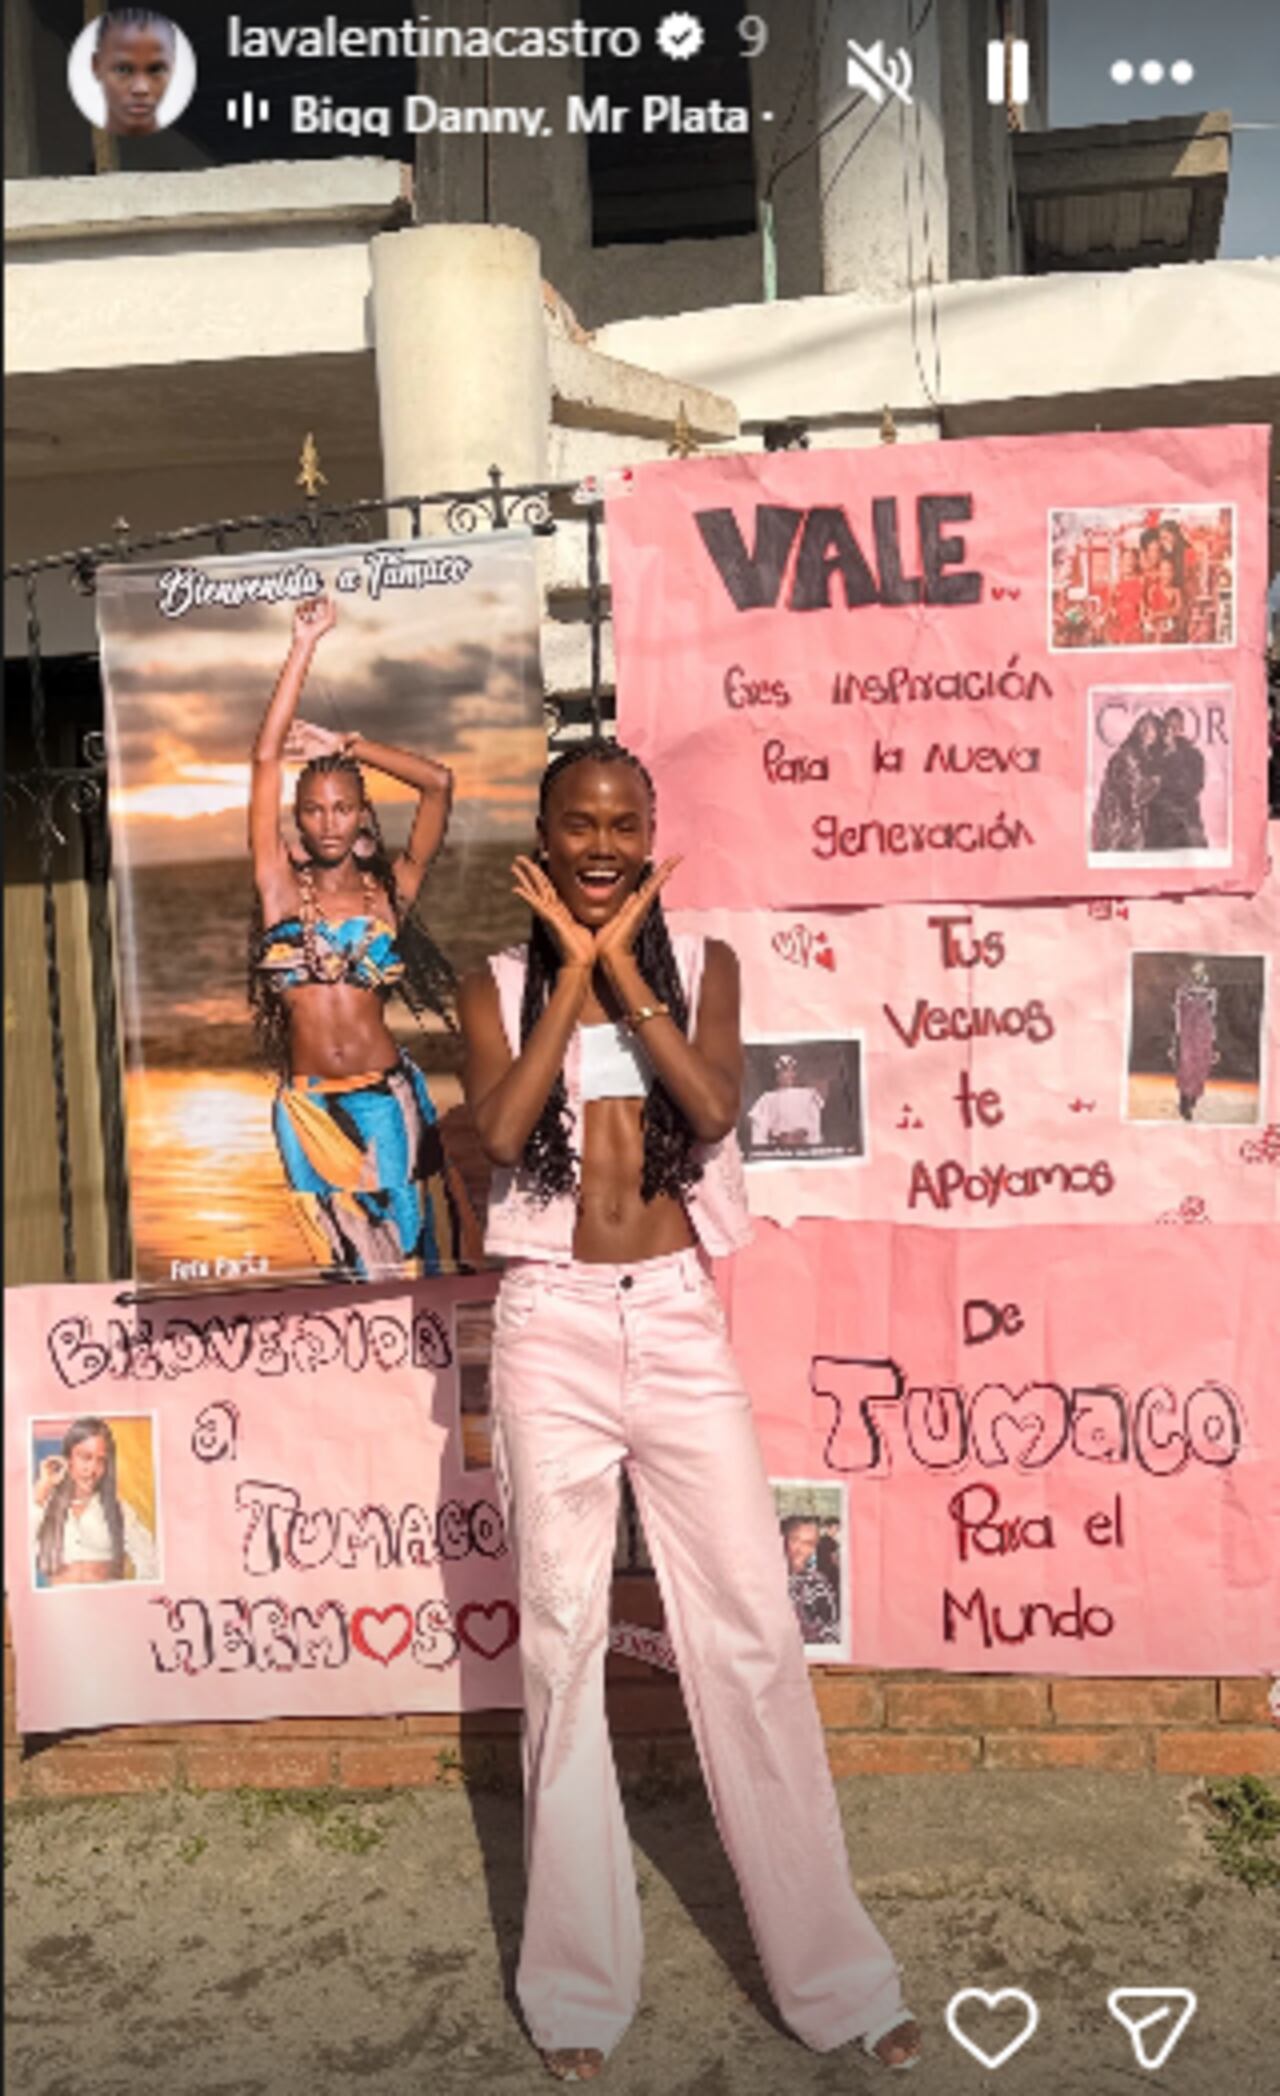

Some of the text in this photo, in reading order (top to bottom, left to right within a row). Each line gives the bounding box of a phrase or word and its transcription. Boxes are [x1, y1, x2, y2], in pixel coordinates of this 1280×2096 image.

[694, 493, 983, 613] VALE
[157, 564, 324, 619] Bienvenida
[336, 567, 361, 593] a
[723, 665, 792, 709] Eres
[763, 738, 830, 784] Para
[873, 740, 904, 774] la
[811, 810, 1036, 861] generación
[928, 915, 1006, 969] Tus
[883, 999, 1055, 1048] Vecinos
[952, 1070, 1005, 1128] te
[963, 1299, 1025, 1346] De
[948, 1482, 1124, 1561] Para el
[942, 1587, 1115, 1649] Mundo
